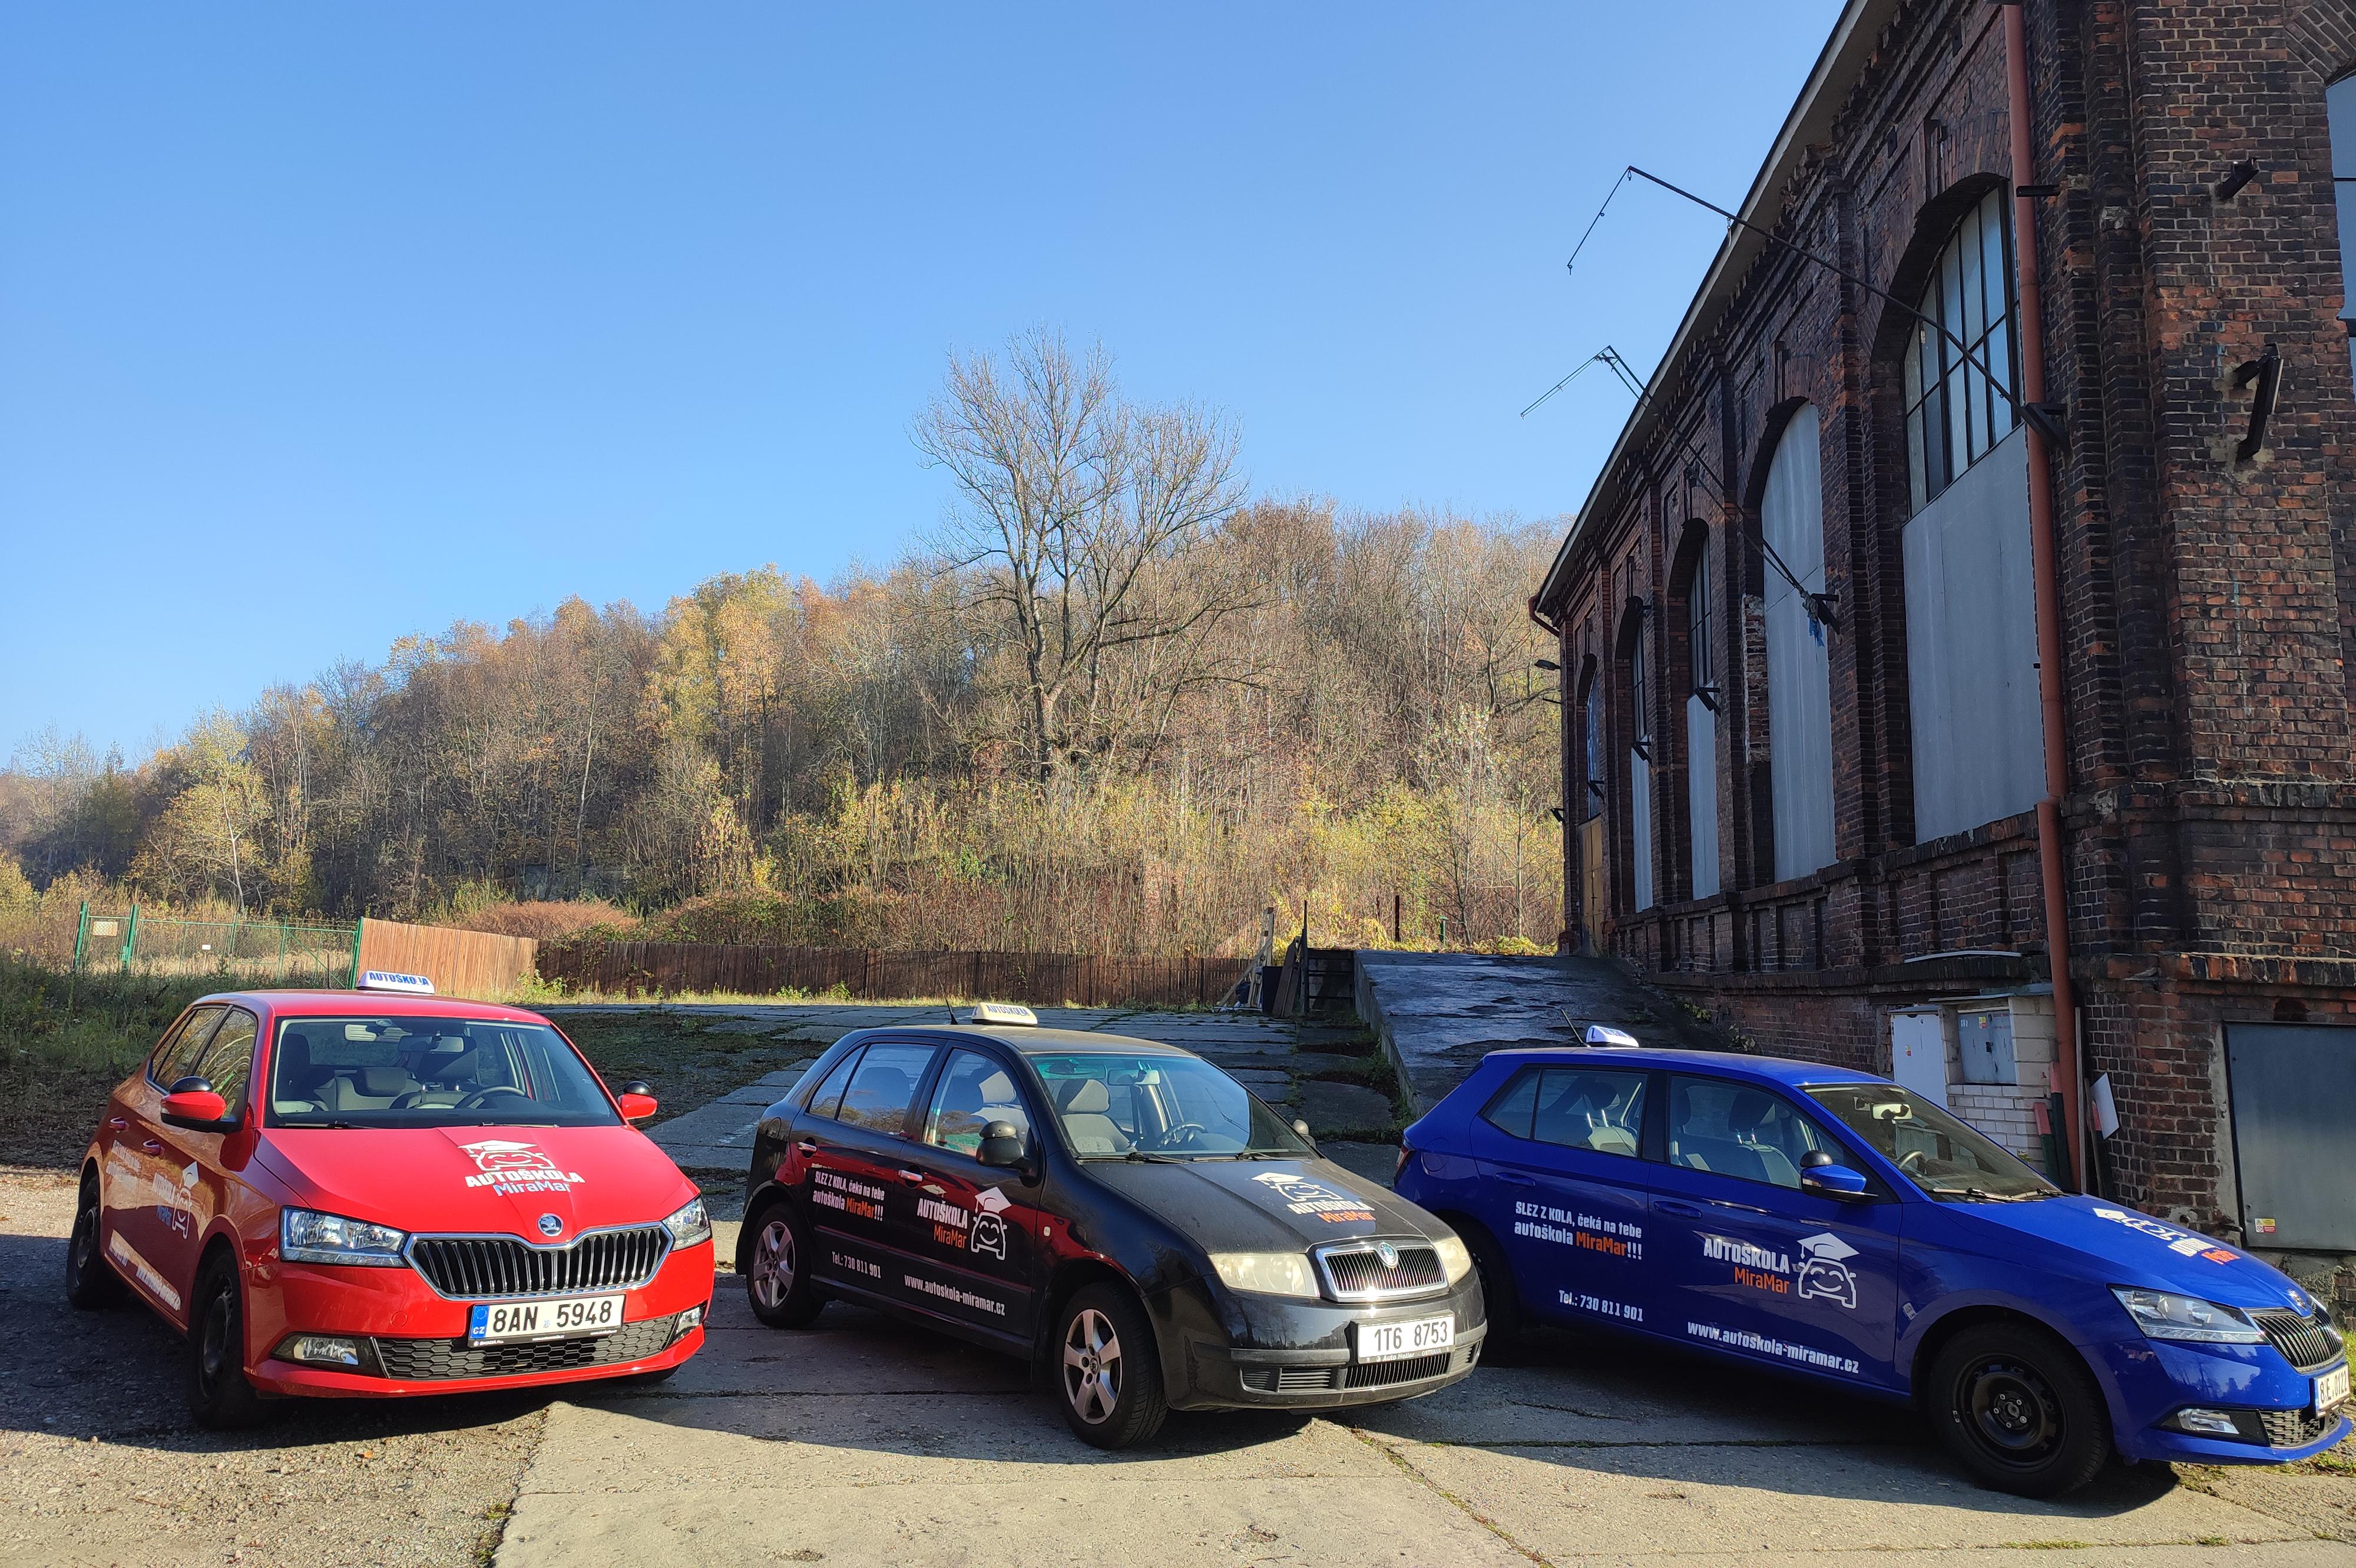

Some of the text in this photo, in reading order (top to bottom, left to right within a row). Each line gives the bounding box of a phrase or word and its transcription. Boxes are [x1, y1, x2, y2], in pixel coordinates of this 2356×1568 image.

[464, 1169, 585, 1187] AUTOŠKOLA
[492, 1181, 571, 1196] MiraMar
[815, 1170, 885, 1201] SLEZ Z KOLA, čeká na tebe
[813, 1190, 884, 1222] autoškola MiraMar!!!
[917, 1198, 968, 1229] AUTOŠKOLA
[1286, 1199, 1375, 1215] AUTOŠKOLA
[1316, 1210, 1376, 1223] MiraMar
[1515, 1201, 1642, 1239] SLEZ Z KOLA, čeká na tebe
[934, 1225, 967, 1249] MiraMar
[1514, 1221, 1642, 1260] autoškola MiraMar!!!
[843, 1255, 855, 1271] 730
[856, 1259, 868, 1274] 811
[869, 1263, 881, 1279] 901
[1703, 1237, 1790, 1274] AUTOŠKOLA
[904, 1274, 1005, 1316] www.autoskola-miramar.cz
[1734, 1266, 1790, 1294] MiraMar
[493, 1300, 613, 1333] 8AN 5948
[1559, 1289, 1643, 1322] Tel.: 730 811 901
[472, 1326, 485, 1335] CZ
[1374, 1321, 1448, 1352] 1T6 8753
[1687, 1321, 1859, 1374] www.autoskola-miramar.cz
[2334, 1369, 2348, 1397] 0122
